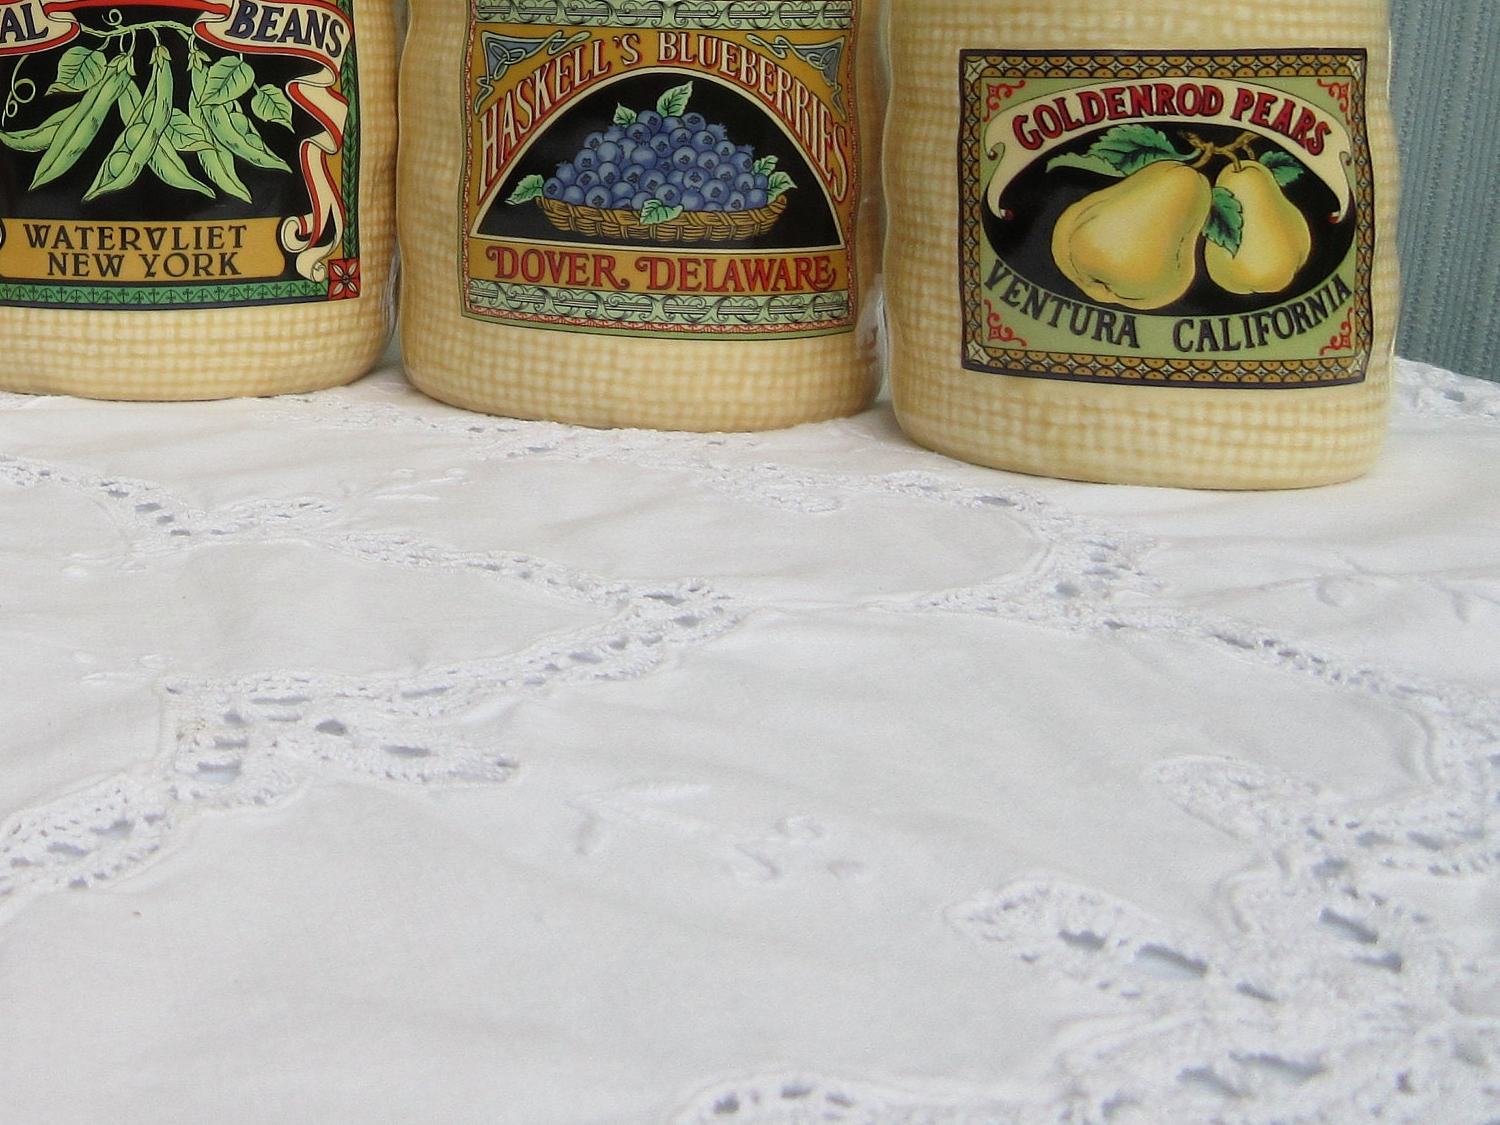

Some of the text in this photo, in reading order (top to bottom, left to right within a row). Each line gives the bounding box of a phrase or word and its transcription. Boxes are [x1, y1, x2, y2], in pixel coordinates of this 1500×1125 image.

[477, 31, 848, 205] HASKELL'S BLUEBERRIES
[1011, 82, 1332, 156] GOLDENROD PEARS
[22, 223, 248, 251] WATERVLIET
[47, 252, 242, 278] NEW YORK
[486, 245, 837, 293] DOVER DELAWARE
[982, 259, 1353, 353] VENTURA CALIFORNIA
